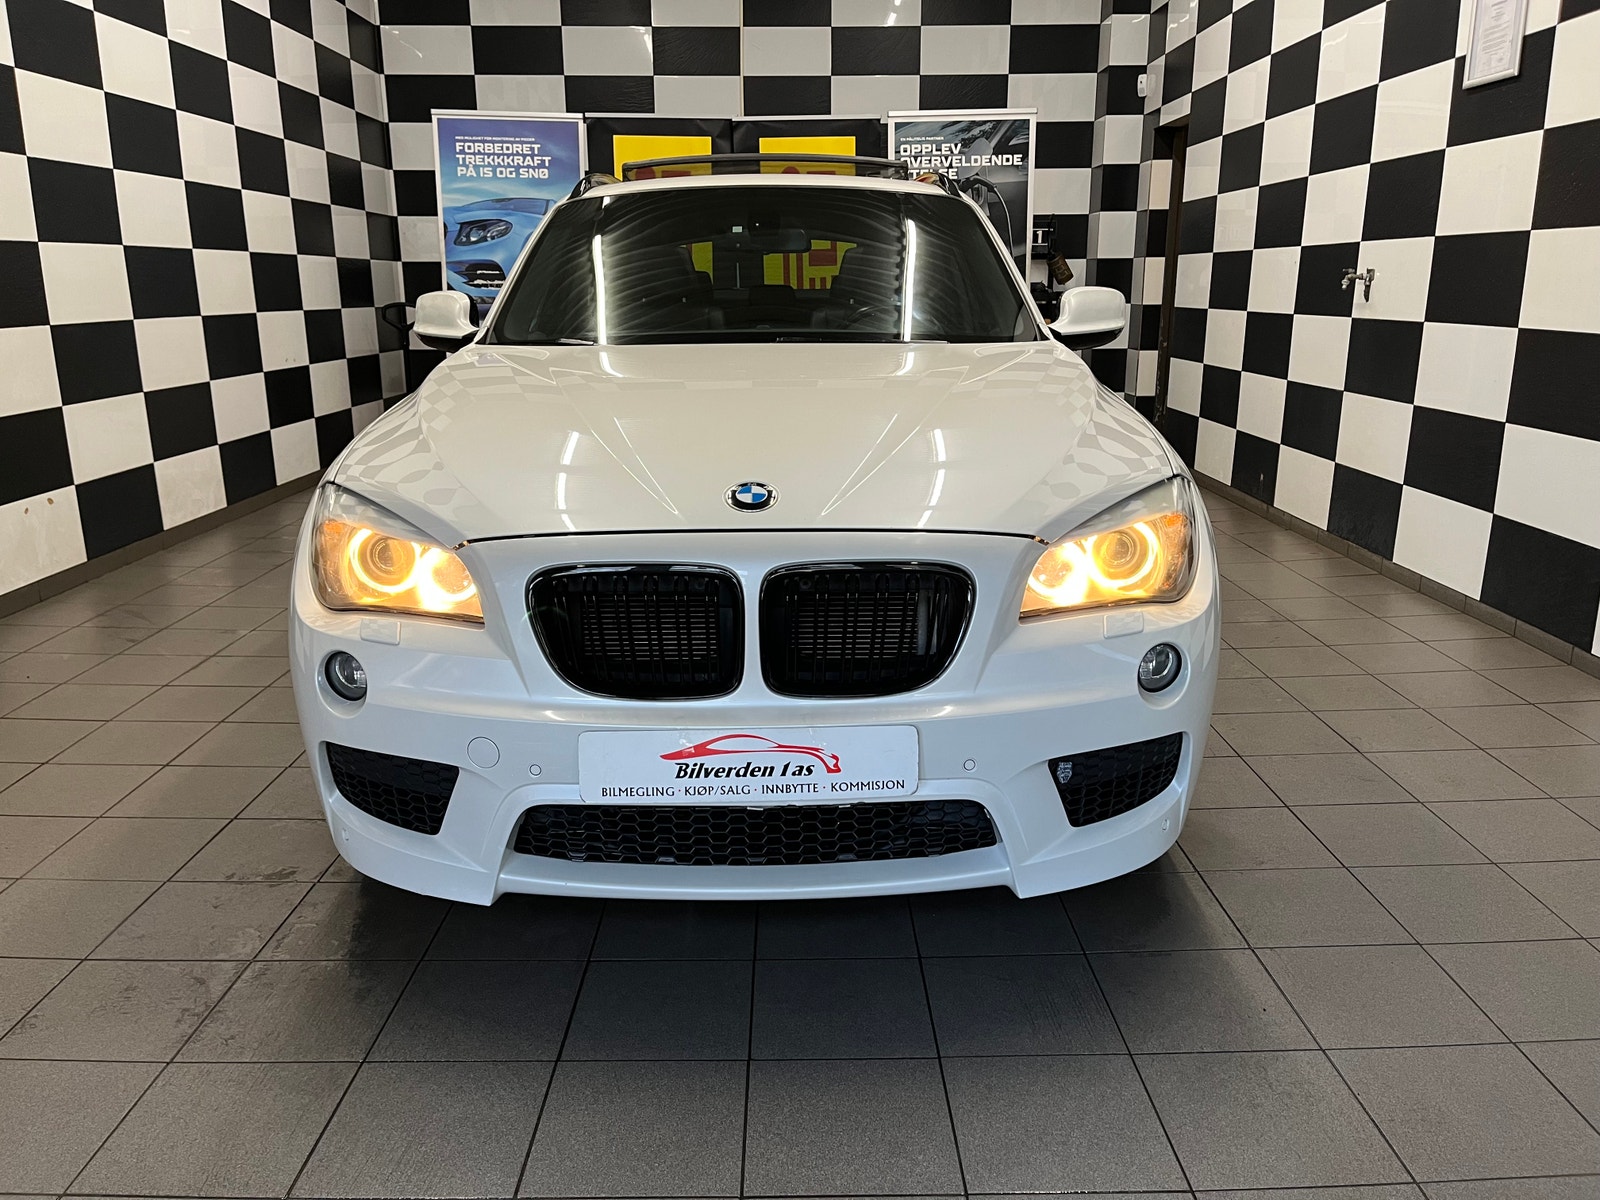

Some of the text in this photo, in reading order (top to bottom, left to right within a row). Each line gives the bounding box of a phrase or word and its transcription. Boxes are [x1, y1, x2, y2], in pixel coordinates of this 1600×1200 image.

[455, 142, 541, 155] FORBEDRET
[900, 143, 961, 156] OPPLEV
[456, 154, 552, 167] TREKKKRAFT
[457, 164, 549, 179] PÅ IS OG SNØ
[675, 761, 775, 779] Bilverden
[791, 764, 815, 777] as
[601, 779, 905, 797] BILMEGLING KJØP/SALG INNBYTTE KOMMISJON
